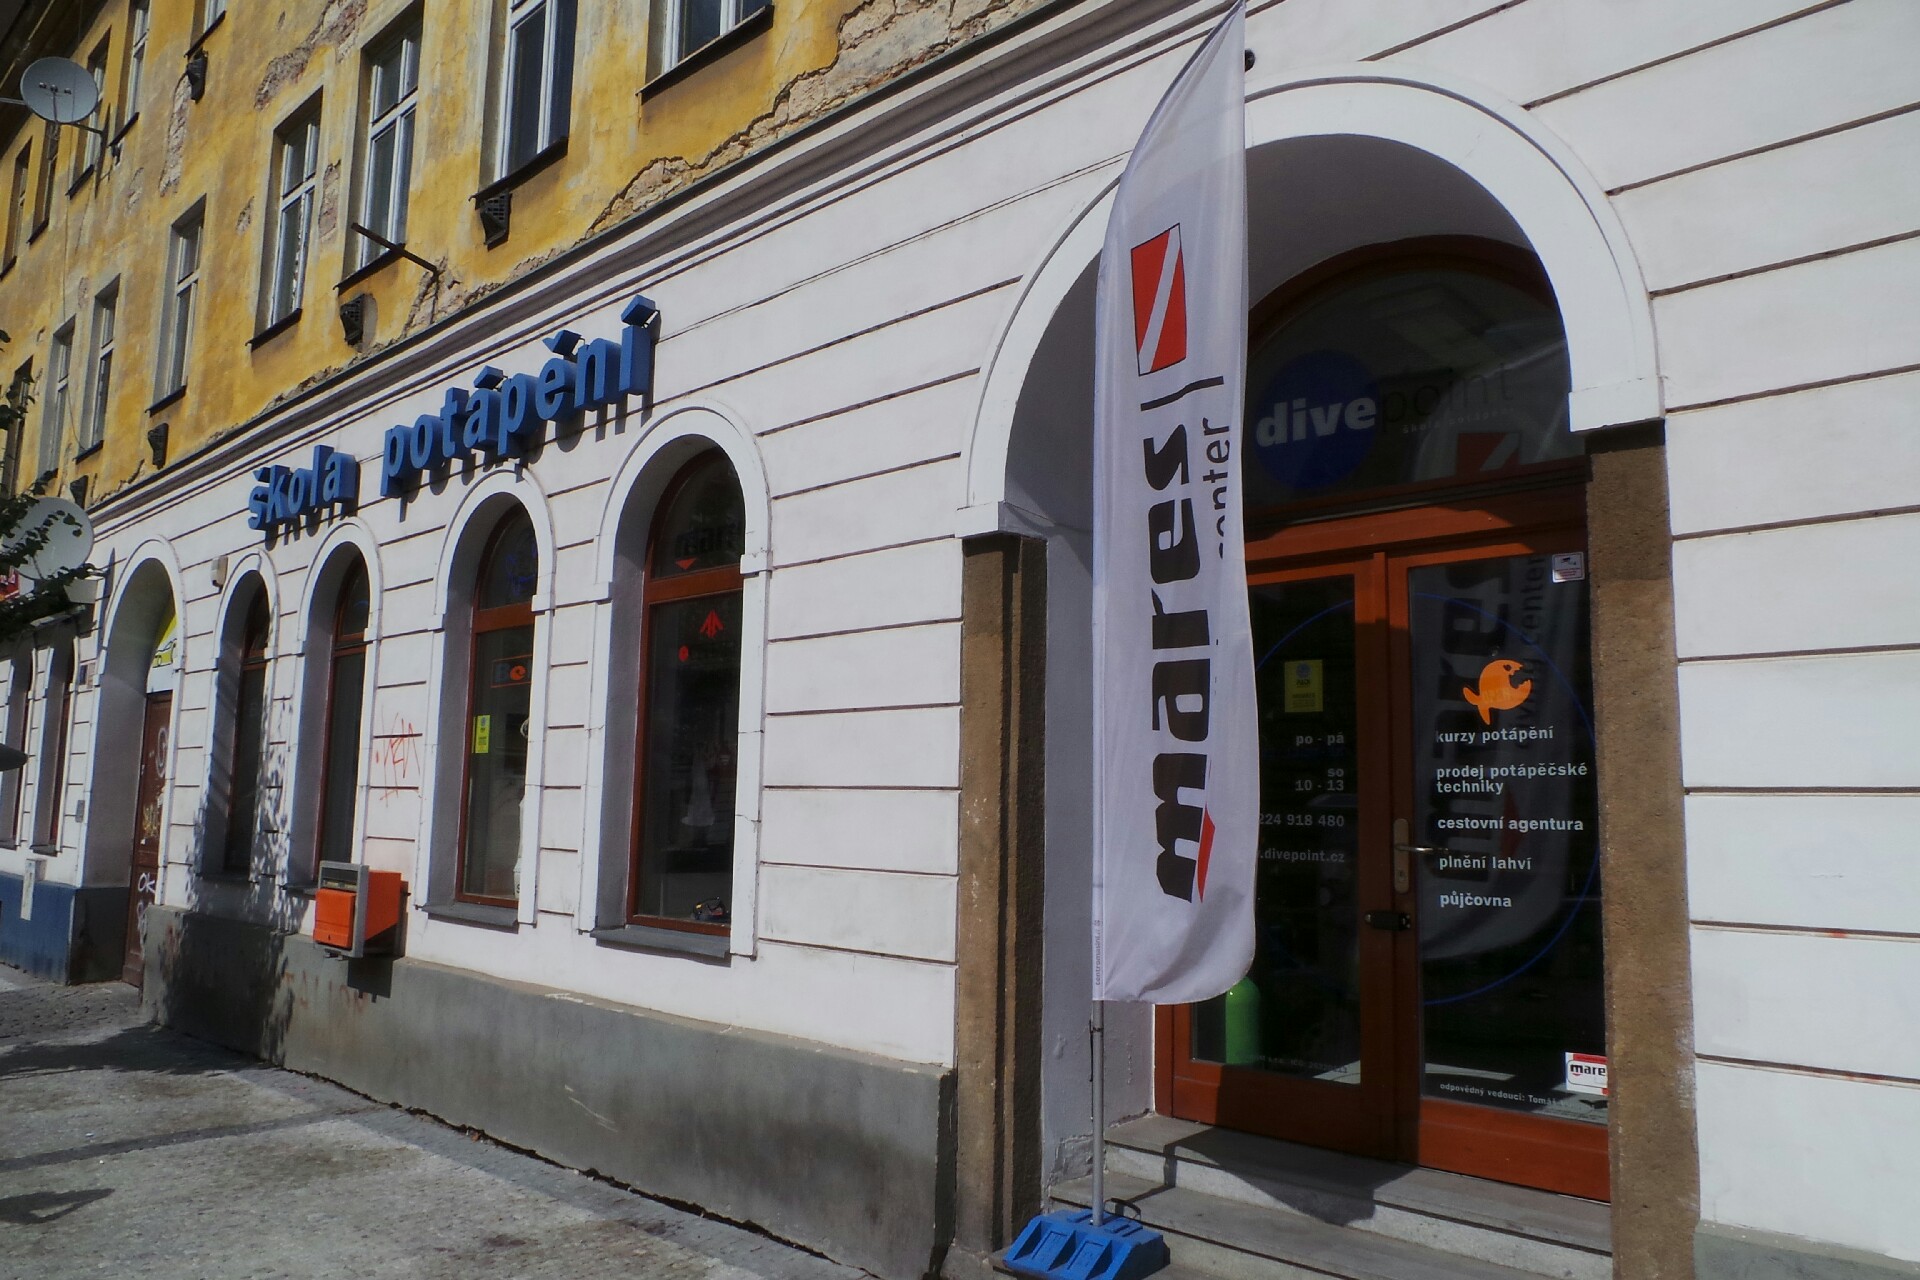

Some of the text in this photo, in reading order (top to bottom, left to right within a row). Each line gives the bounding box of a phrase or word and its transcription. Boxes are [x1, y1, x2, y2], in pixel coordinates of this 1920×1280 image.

[248, 295, 656, 530] škola potápění
[1256, 363, 1514, 447] dive point
[1202, 417, 1230, 560] nter
[1143, 423, 1211, 904] mares
[1295, 735, 1314, 747] po
[1327, 731, 1345, 746] pá
[1436, 726, 1554, 744] kurzy potápění
[1327, 768, 1344, 777] so
[1436, 762, 1588, 780] prodej potápěčské
[1295, 779, 1312, 791] 10
[1327, 779, 1344, 791] 13
[1436, 780, 1504, 795] techniky
[1287, 814, 1313, 826] 918
[1318, 814, 1345, 827] 480
[1437, 816, 1584, 833] cestovní agentura
[1258, 848, 1345, 863] .divepoint.cz
[1439, 855, 1532, 871] plnění lahví
[1440, 890, 1512, 909] půjčovna
[1570, 1064, 1606, 1077] mare
